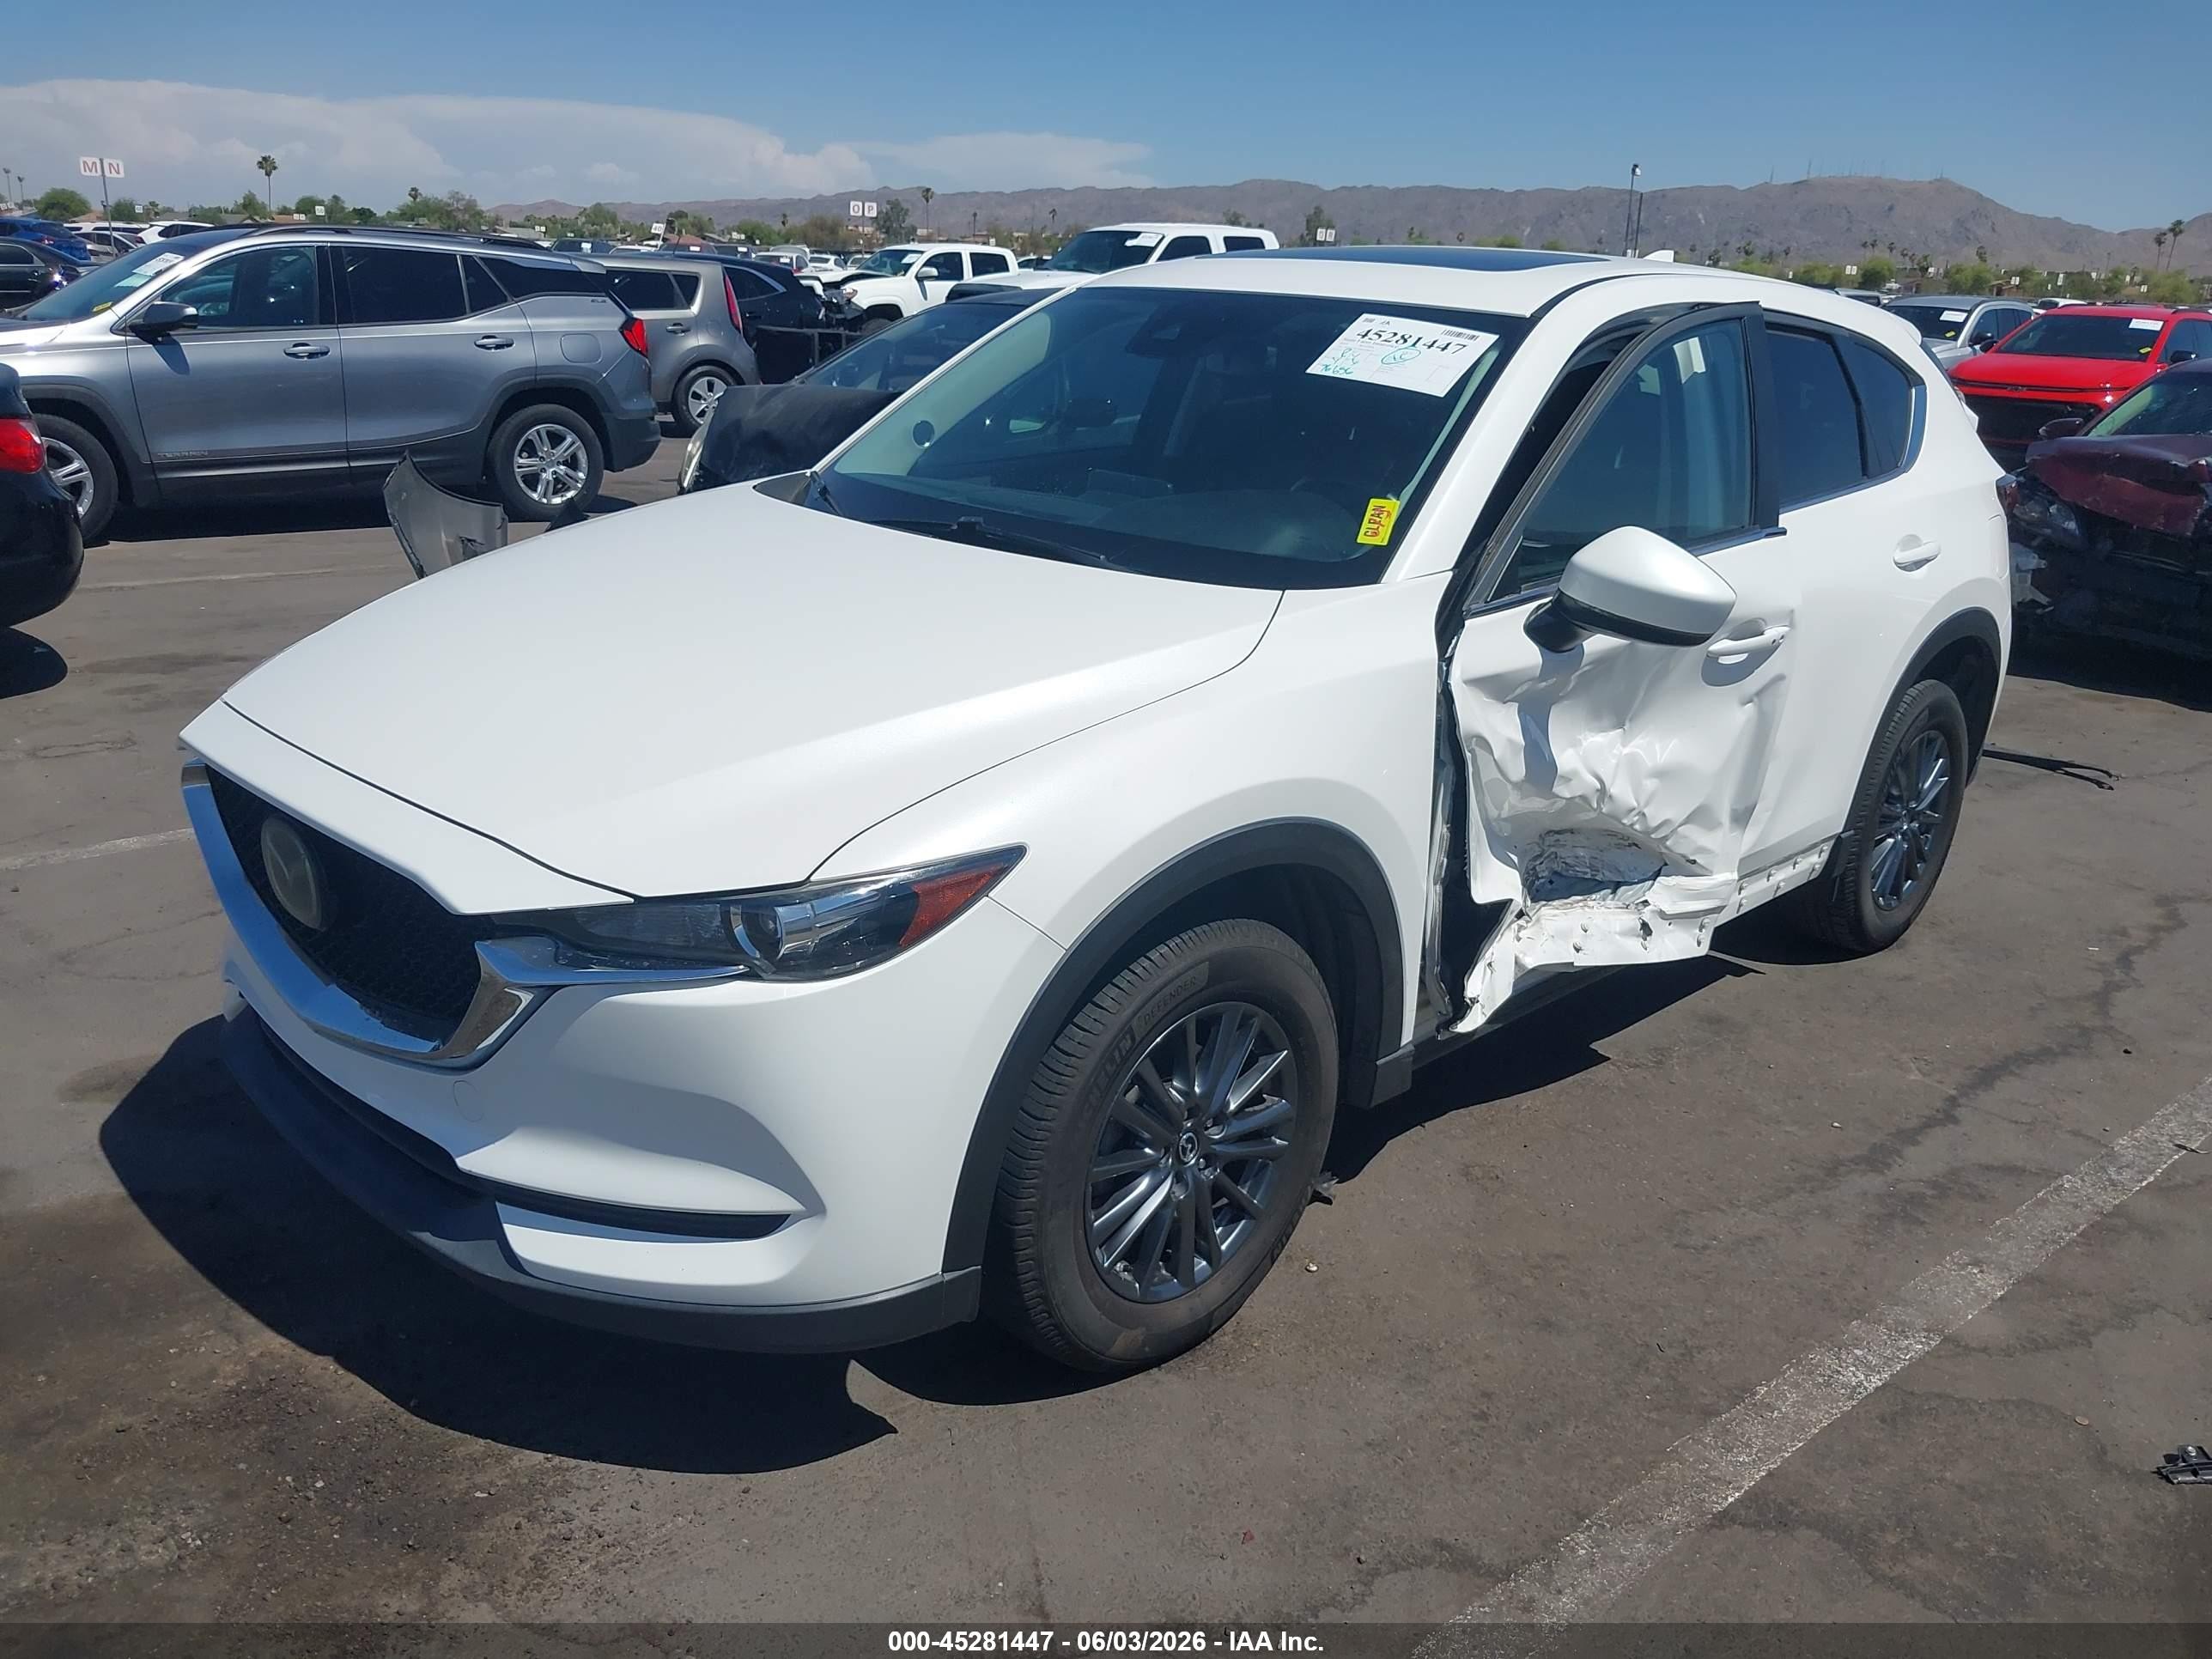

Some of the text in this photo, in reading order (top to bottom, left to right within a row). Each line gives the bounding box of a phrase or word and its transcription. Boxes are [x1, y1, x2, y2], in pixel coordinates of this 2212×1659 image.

[82, 161, 98, 173] M
[109, 164, 120, 174] N
[853, 204, 860, 214] O
[867, 205, 873, 214] P
[1357, 328, 1468, 355] 45281447
[1144, 976, 1196, 1025] DEFENDER
